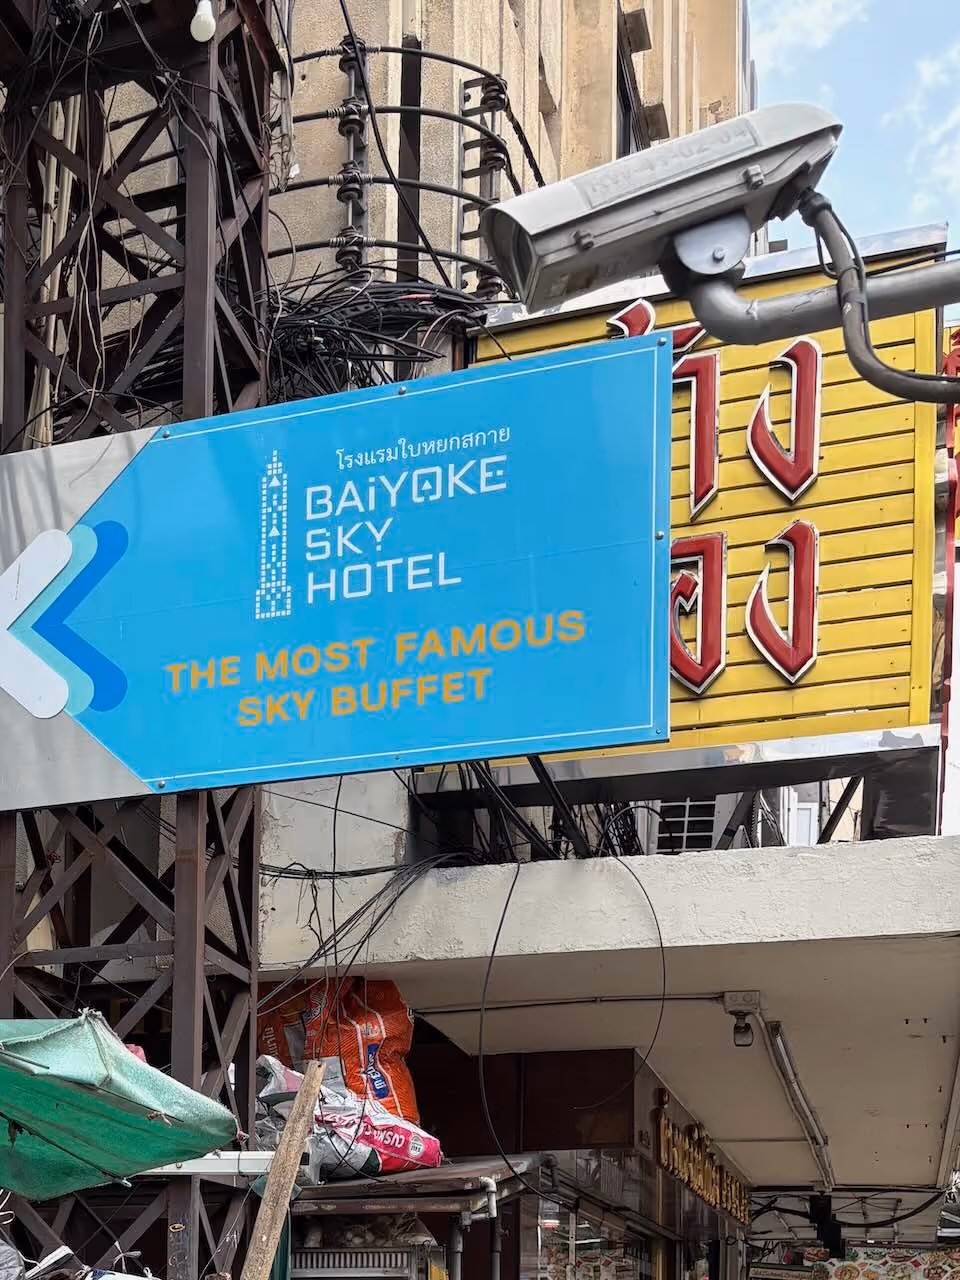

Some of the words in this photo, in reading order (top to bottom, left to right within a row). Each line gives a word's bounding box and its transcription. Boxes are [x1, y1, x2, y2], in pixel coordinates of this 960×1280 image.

[336, 426, 511, 470] โรงแรมใบหยกสกาย
[305, 517, 393, 561] SKY
[307, 552, 462, 604] HOTEL
[163, 656, 240, 693] THE
[256, 638, 374, 682] MOST
[396, 610, 586, 665] FAMOUS
[238, 689, 318, 727] SKY
[331, 668, 492, 717] BUFFET
